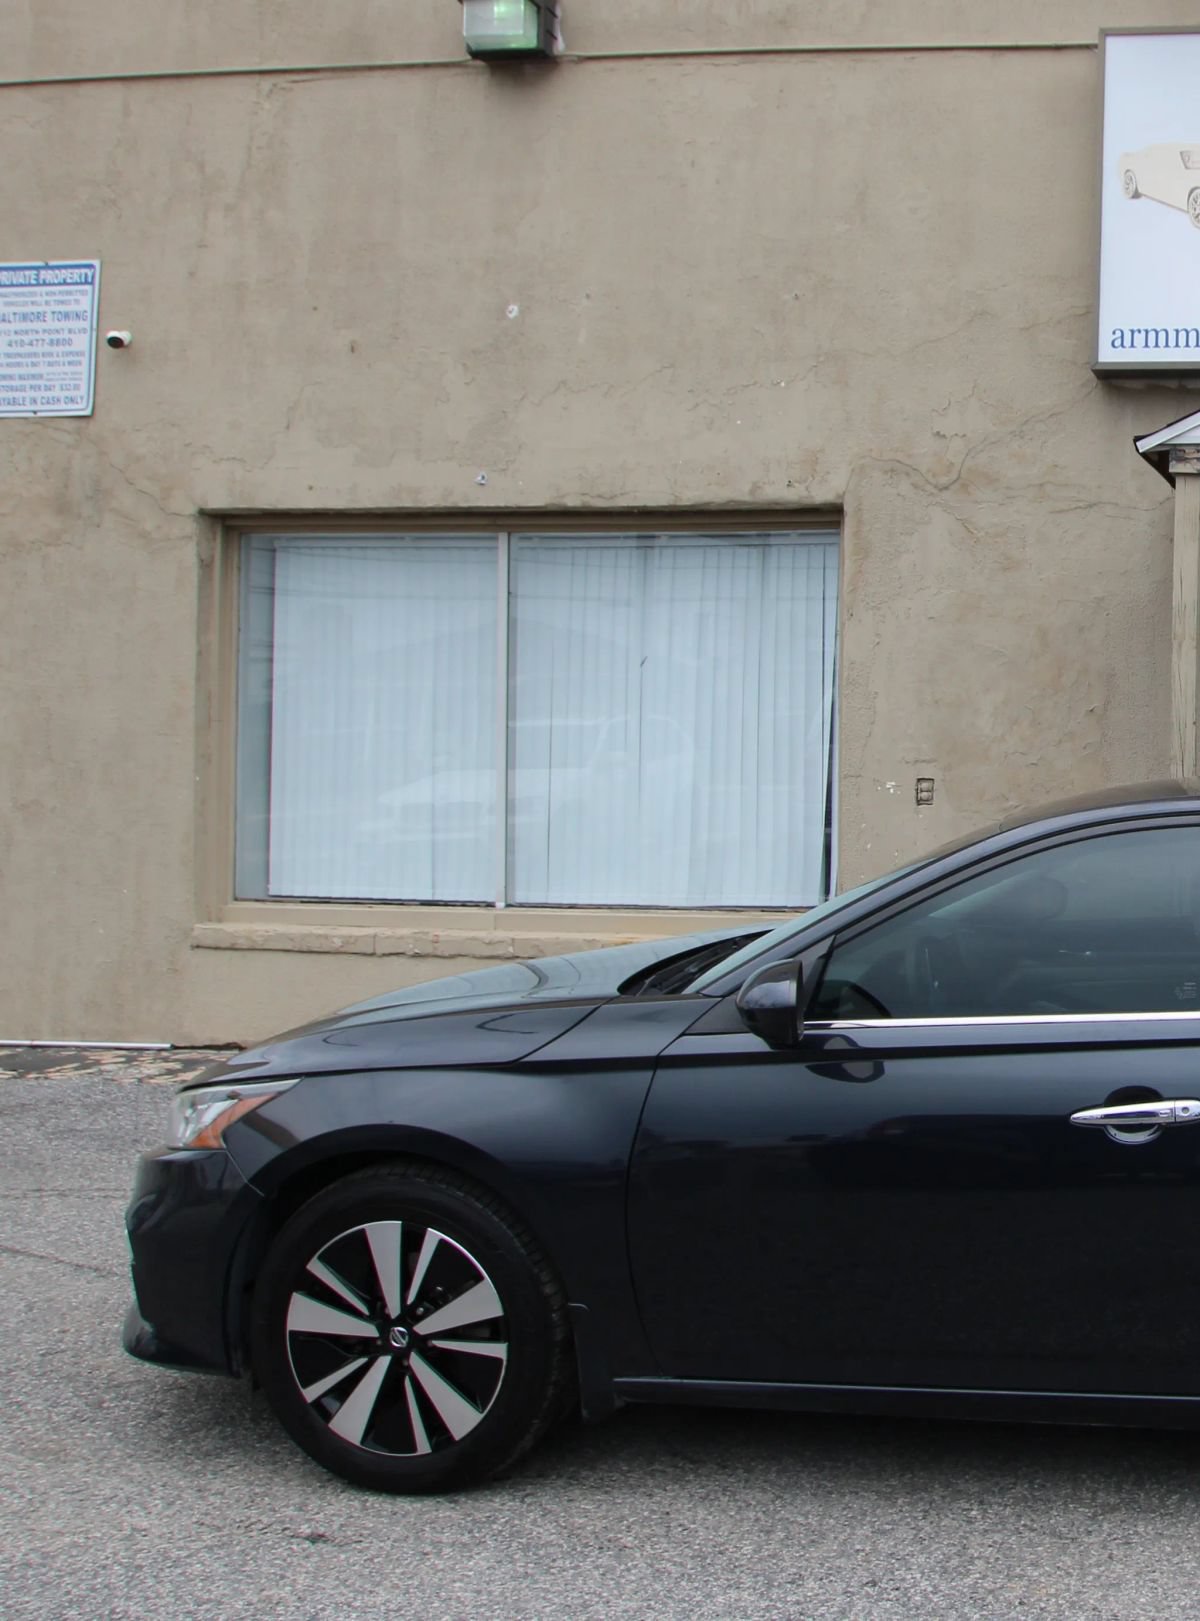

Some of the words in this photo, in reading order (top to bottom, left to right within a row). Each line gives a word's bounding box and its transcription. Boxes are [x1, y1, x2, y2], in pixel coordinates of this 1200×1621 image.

[0, 271, 38, 286] RIVATE
[39, 269, 94, 285] PROPERTY
[0, 311, 47, 323] ALTIMORE
[51, 310, 88, 322] TOWING
